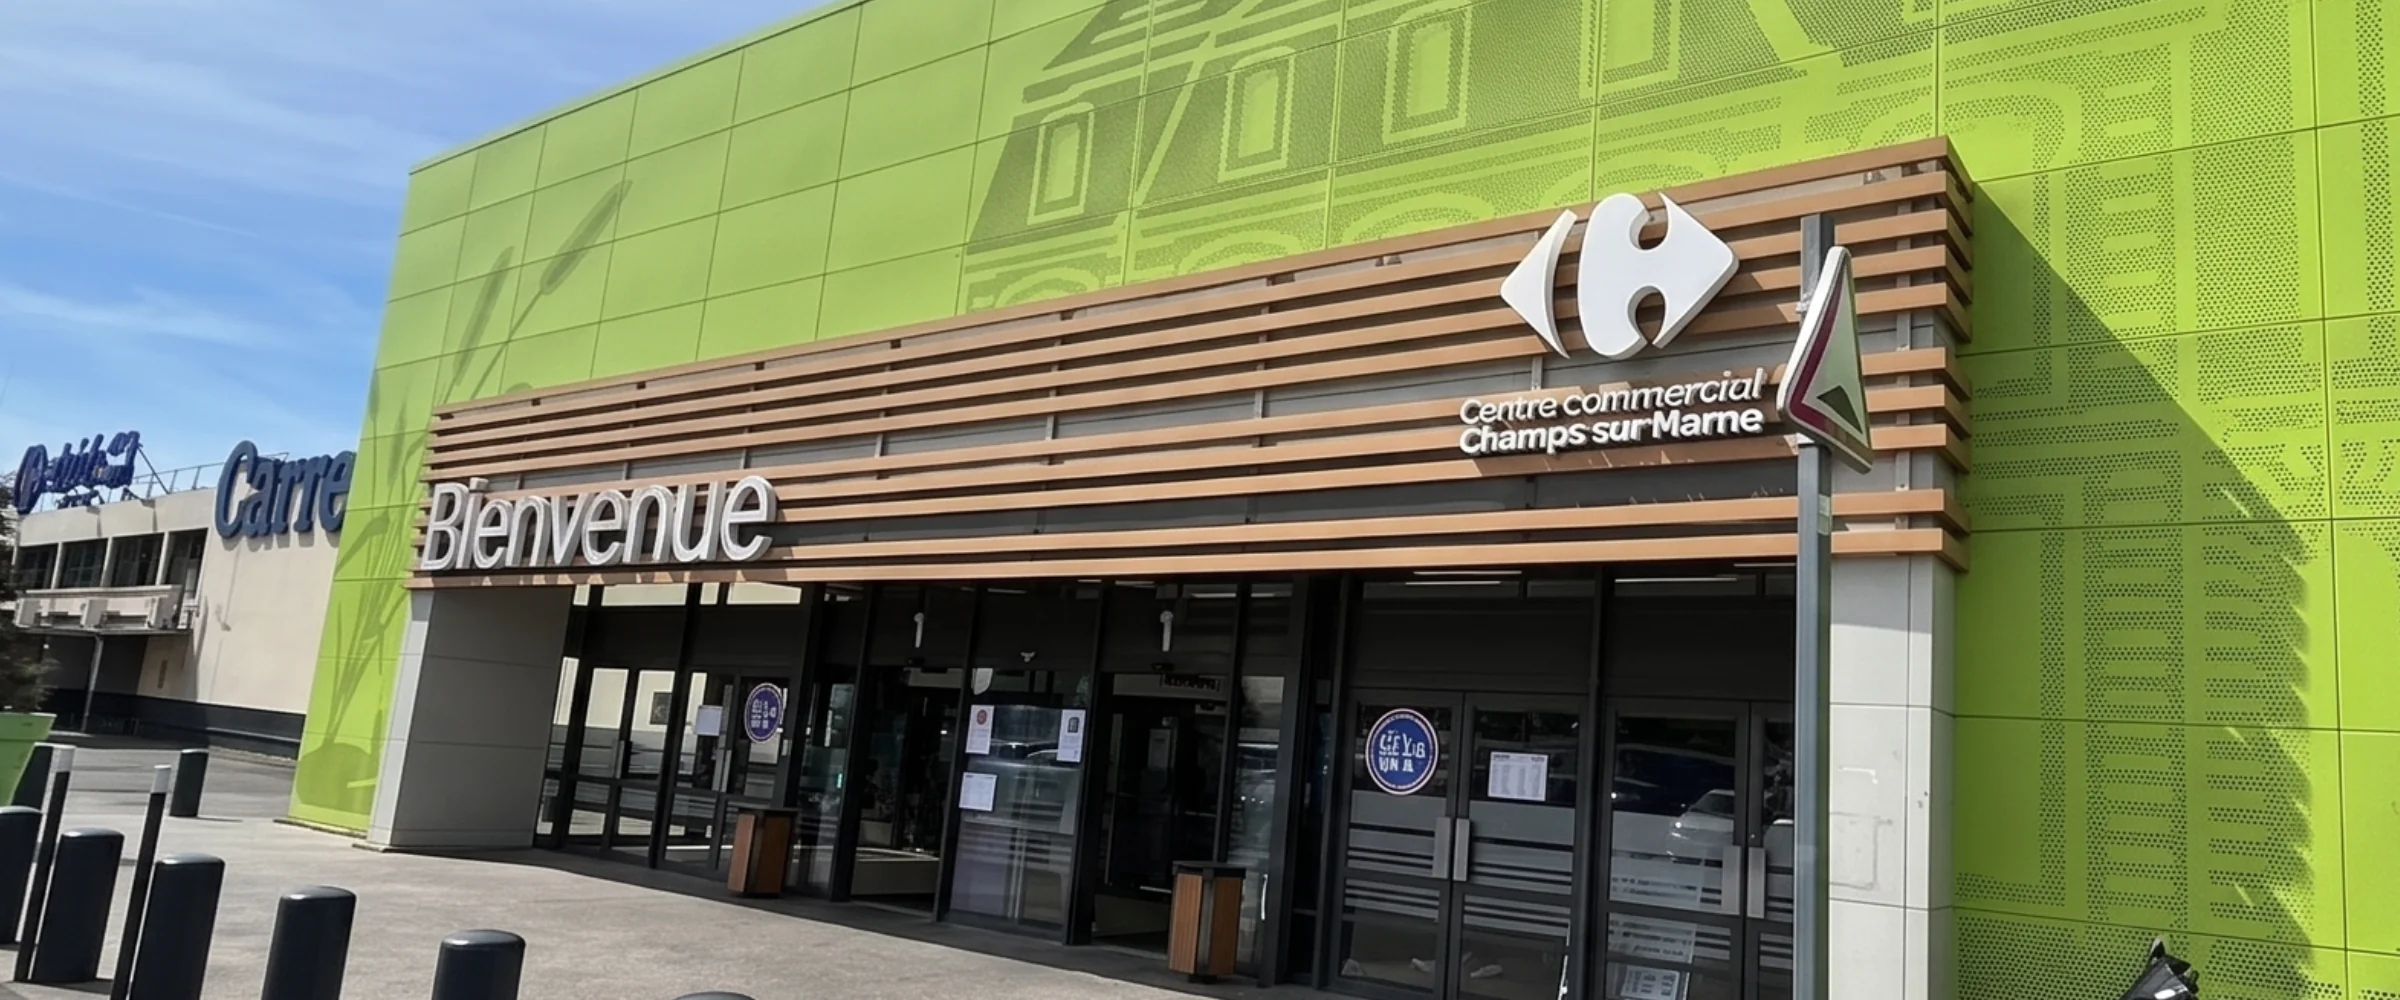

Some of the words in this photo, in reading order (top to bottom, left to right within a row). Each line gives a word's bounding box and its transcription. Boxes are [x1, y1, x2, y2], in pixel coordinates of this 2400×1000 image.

[1459, 396, 1556, 425] Centre
[1563, 367, 1767, 416] commercial
[1459, 424, 1588, 455] Champs
[1592, 418, 1652, 445] sur
[1652, 407, 1764, 439] Marne
[421, 475, 779, 571] Bienvenue
